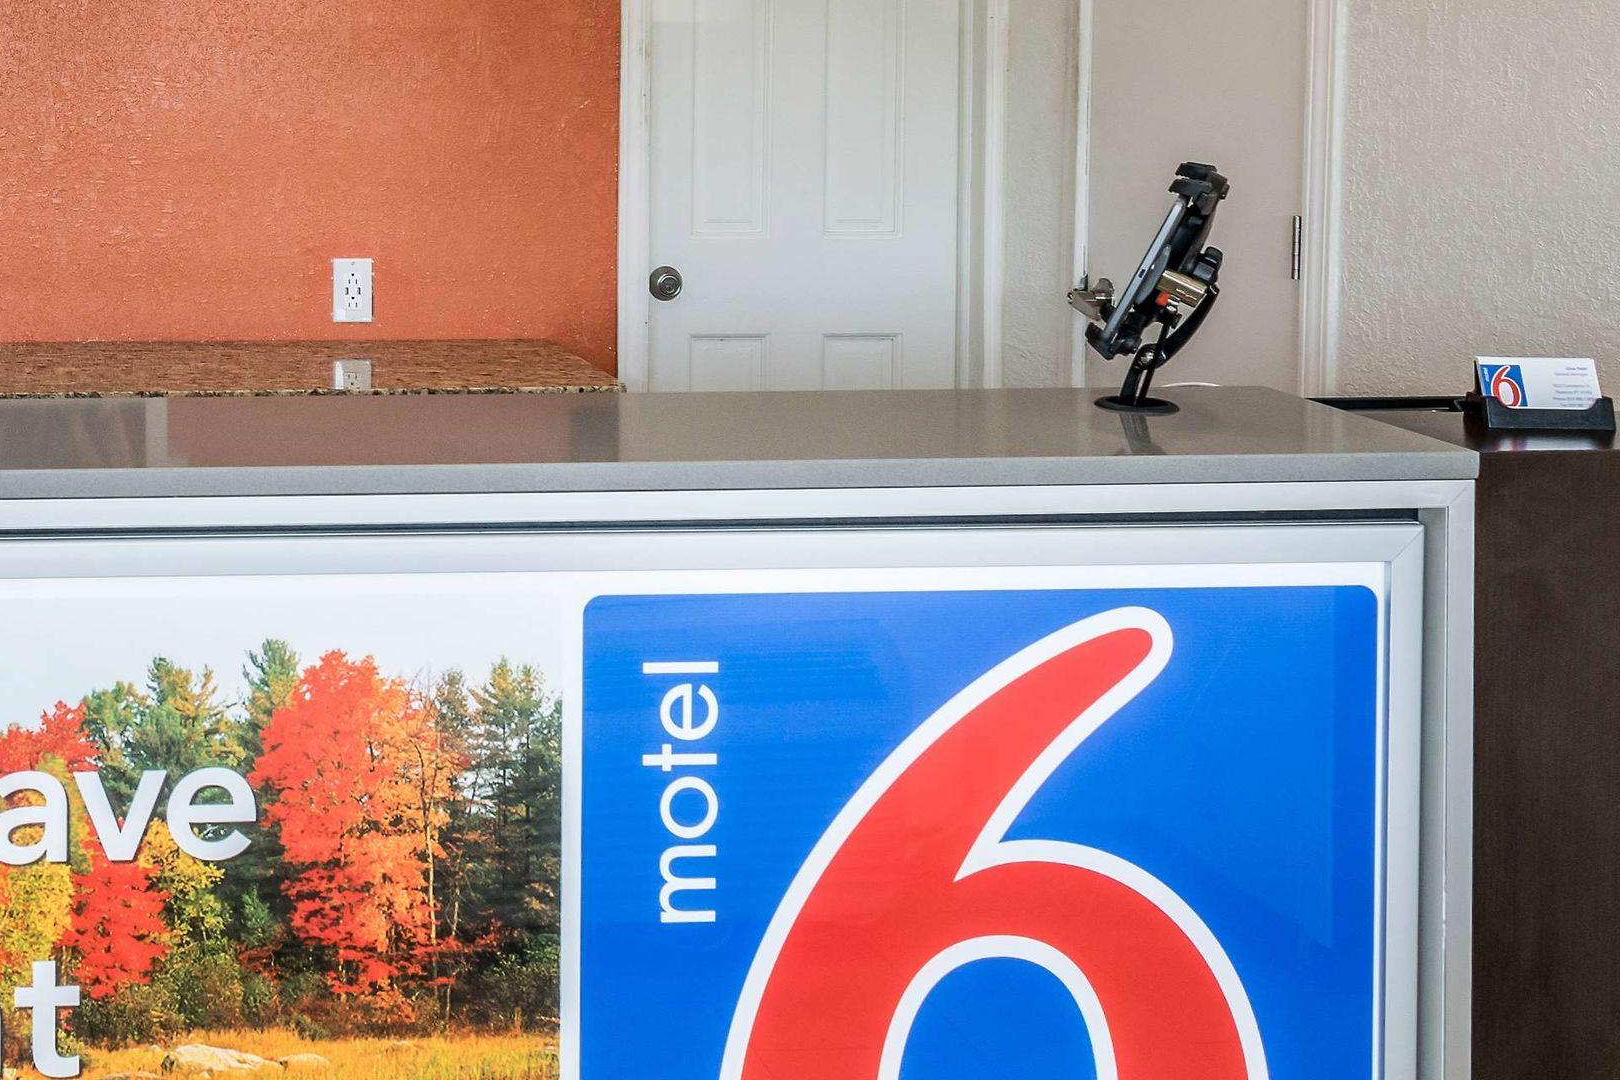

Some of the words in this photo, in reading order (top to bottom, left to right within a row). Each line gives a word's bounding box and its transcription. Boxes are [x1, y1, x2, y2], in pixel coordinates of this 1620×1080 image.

[1490, 365, 1522, 408] 6
[643, 660, 720, 924] motel
[718, 606, 1271, 1080] 6
